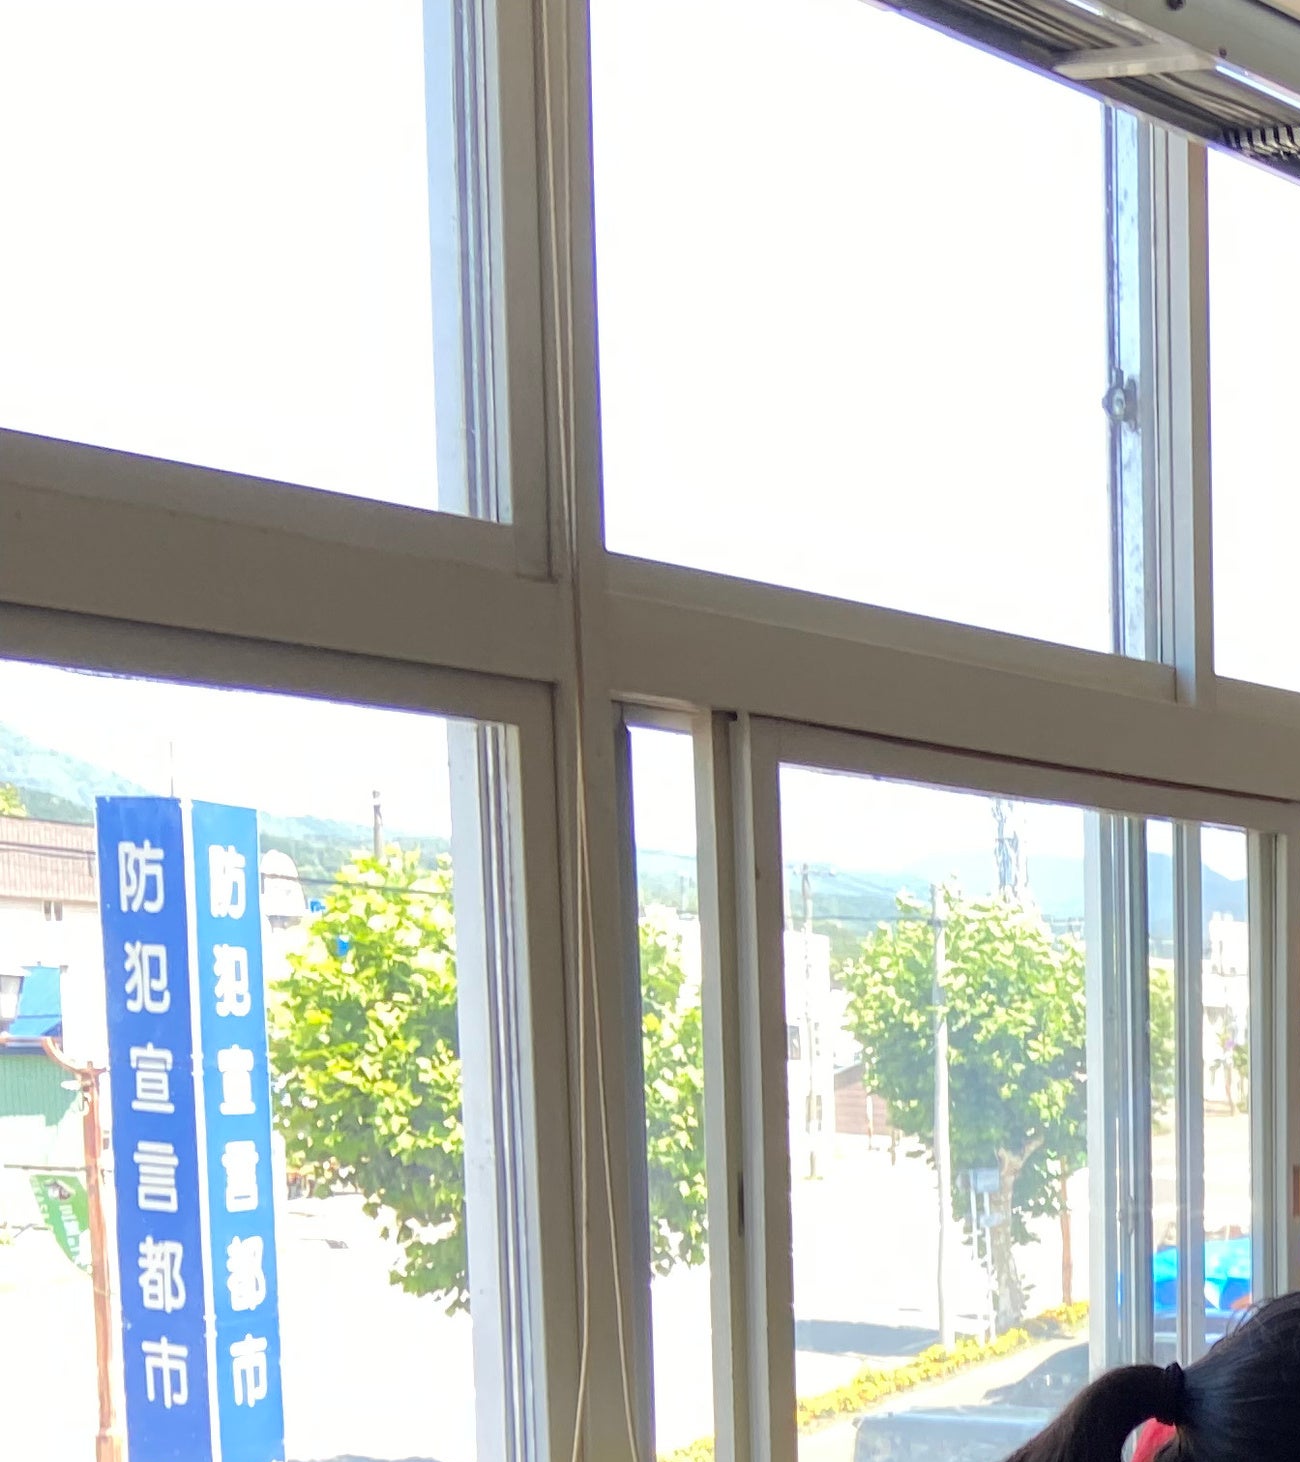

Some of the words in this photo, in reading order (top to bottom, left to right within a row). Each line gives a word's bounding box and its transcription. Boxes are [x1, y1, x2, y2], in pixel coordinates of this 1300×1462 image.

[118, 839, 188, 1408] 防犯宣言都市
[208, 844, 268, 1408] 防犯宣言都市
